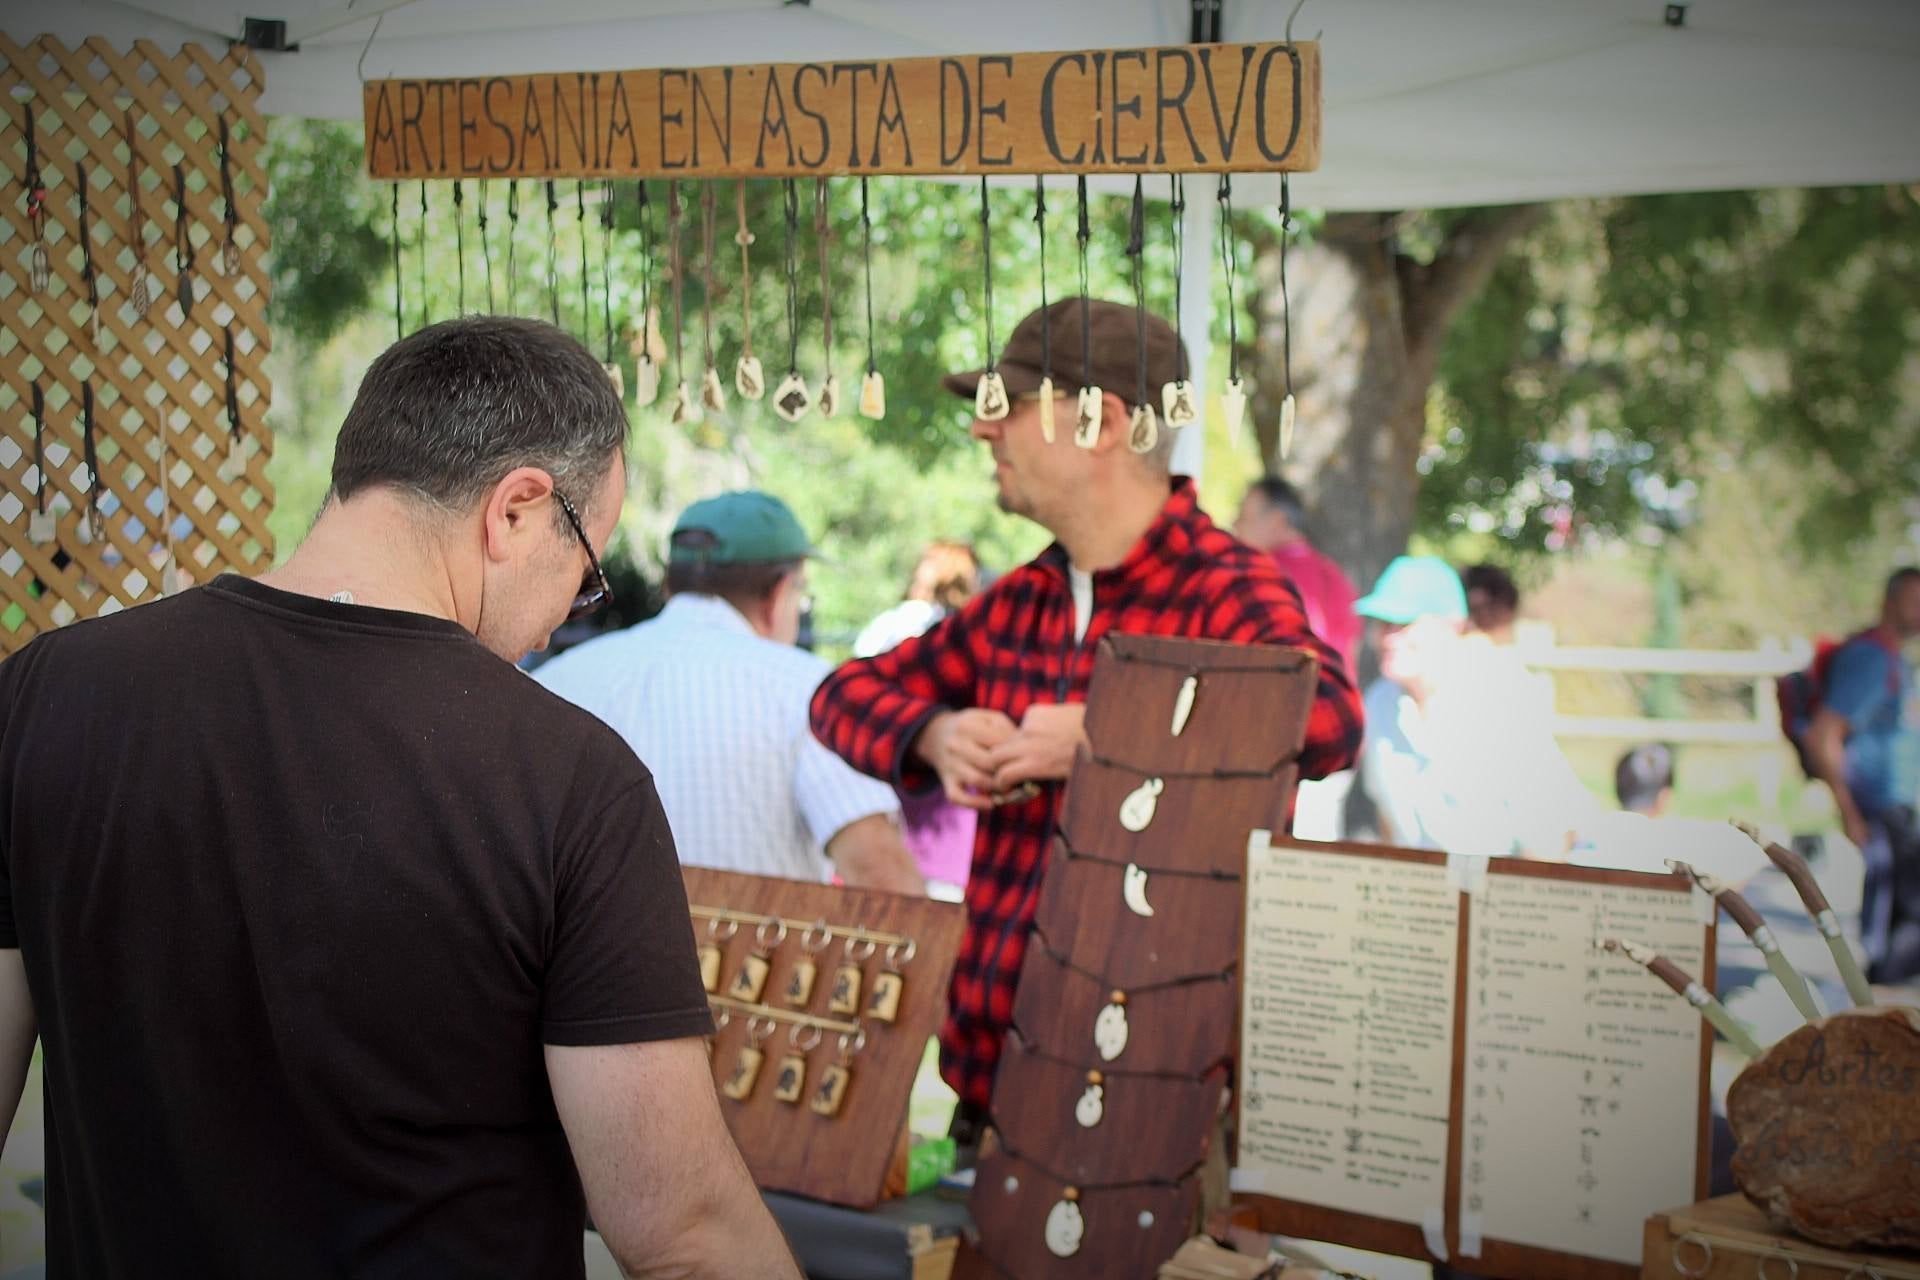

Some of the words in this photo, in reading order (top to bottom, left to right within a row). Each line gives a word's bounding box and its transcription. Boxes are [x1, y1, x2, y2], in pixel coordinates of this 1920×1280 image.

[369, 72, 639, 174] ARTESANIA
[659, 66, 732, 170] EN
[755, 62, 913, 169] ASTA
[940, 56, 1013, 167] DE
[1040, 44, 1302, 166] CIERVO
